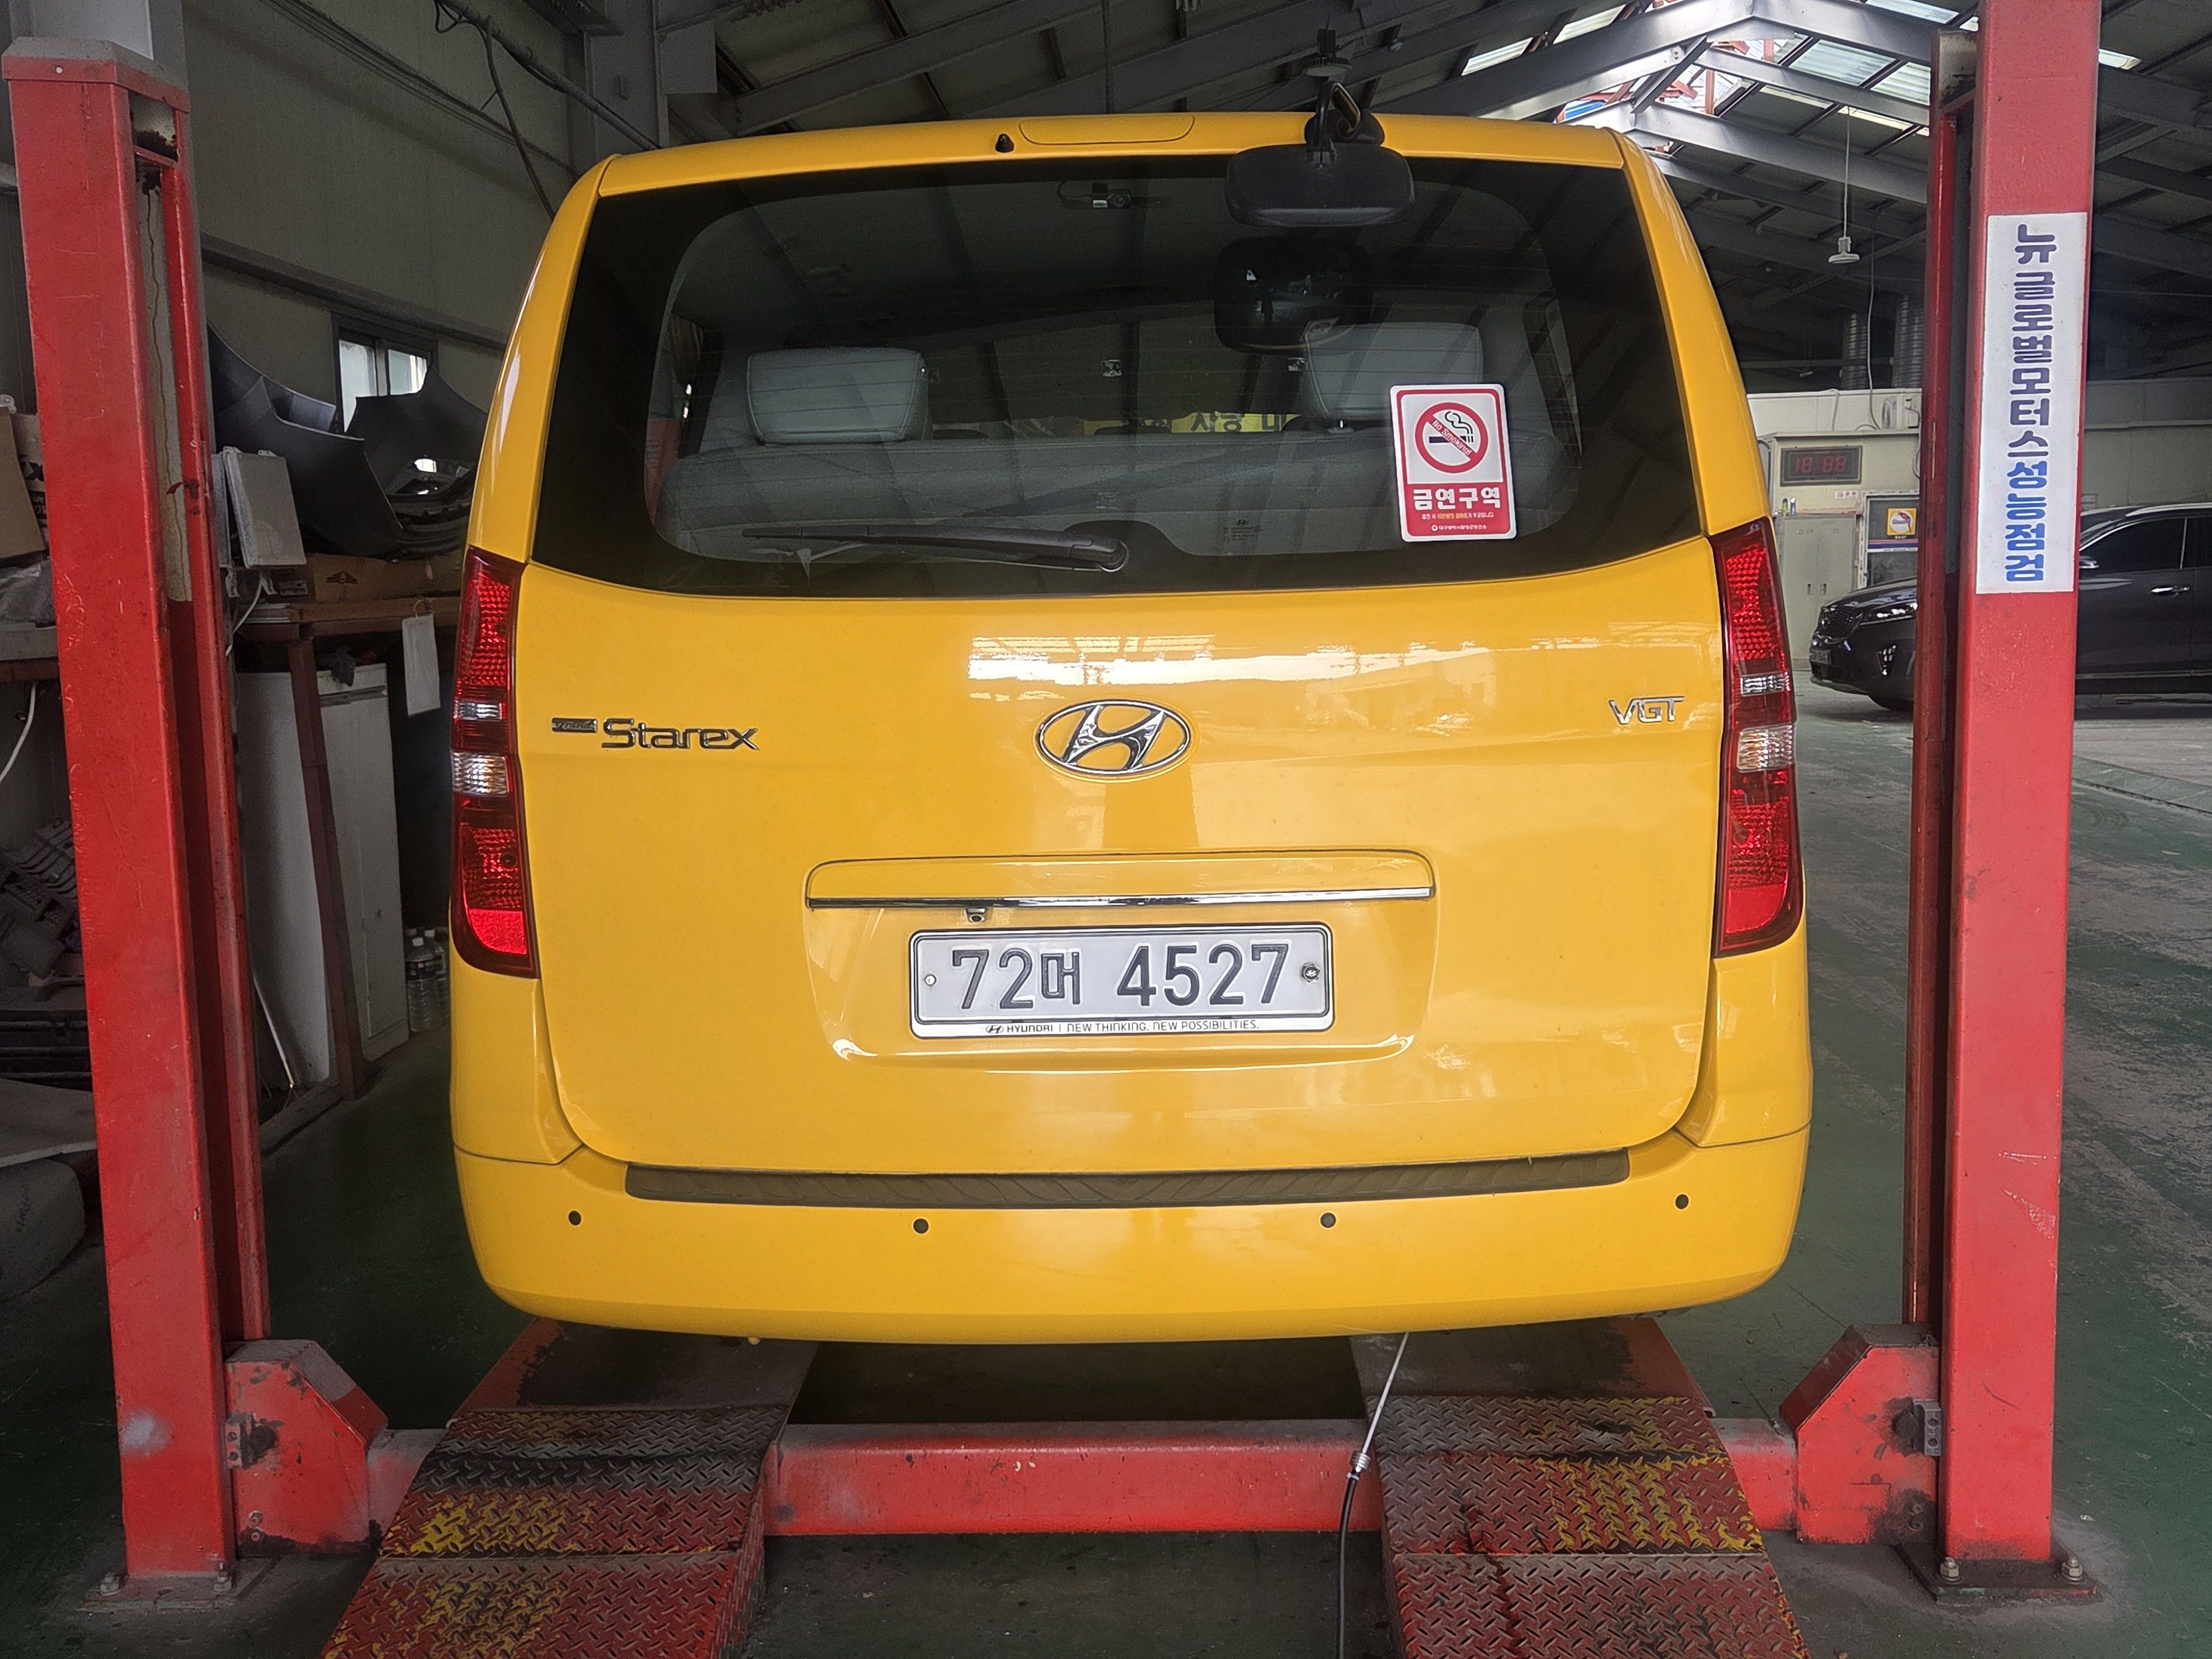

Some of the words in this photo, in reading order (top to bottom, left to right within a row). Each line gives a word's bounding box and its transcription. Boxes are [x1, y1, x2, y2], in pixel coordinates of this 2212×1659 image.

[1413, 487, 1501, 510] 금연구역
[1609, 696, 1685, 725] VGT
[602, 718, 760, 750] Starex
[1117, 943, 1288, 1006] 4527
[1067, 1024, 1092, 1032] NEW
[1095, 1022, 1149, 1031] THINKING.
[1154, 1021, 1177, 1030] NEW
[1182, 1020, 1259, 1030] POSSIBILITIES.
